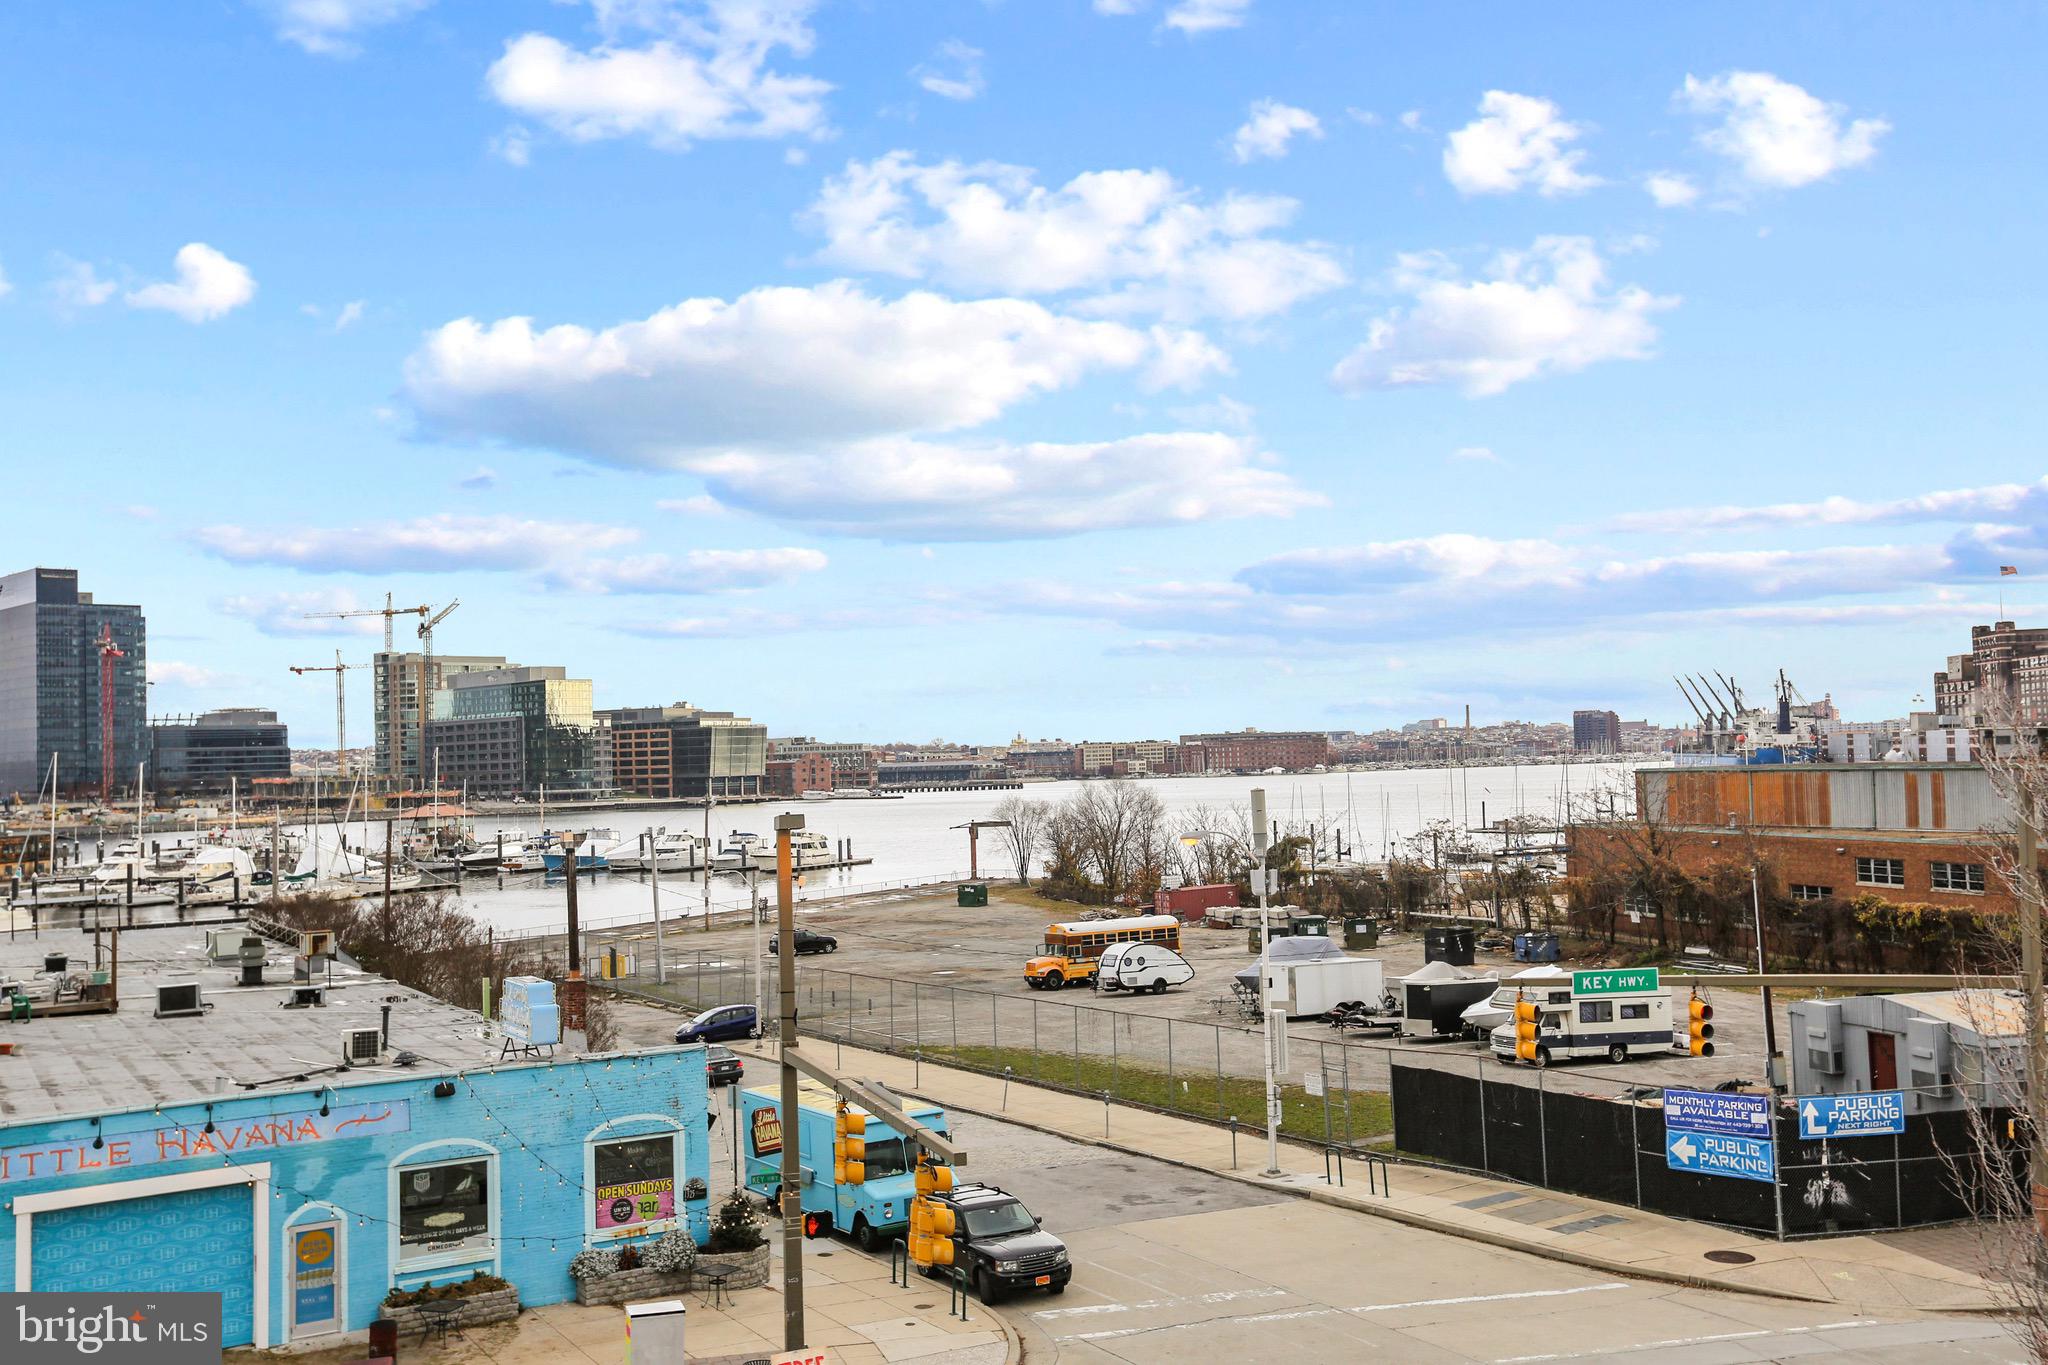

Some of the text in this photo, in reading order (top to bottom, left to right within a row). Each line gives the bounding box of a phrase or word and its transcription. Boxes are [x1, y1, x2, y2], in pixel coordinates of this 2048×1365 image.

[1583, 976, 1649, 990] KEY HWY.
[1669, 1095, 1762, 1112] MONTHLY PARKING
[1835, 1096, 1893, 1110] PUBLIC
[757, 1110, 776, 1125] Little
[1682, 1106, 1749, 1120] AVAILABLE
[1828, 1107, 1900, 1123] PARKING
[755, 1122, 783, 1141] HAVANA
[1837, 1120, 1892, 1130] NEXT RIGHT
[0, 1118, 322, 1180] ITTLE HAVANA
[1705, 1138, 1760, 1157] PUBLIC
[1699, 1152, 1768, 1173] PARKING
[752, 1176, 764, 1184] KEY
[598, 1180, 672, 1200] OPEN SUNDAYS
